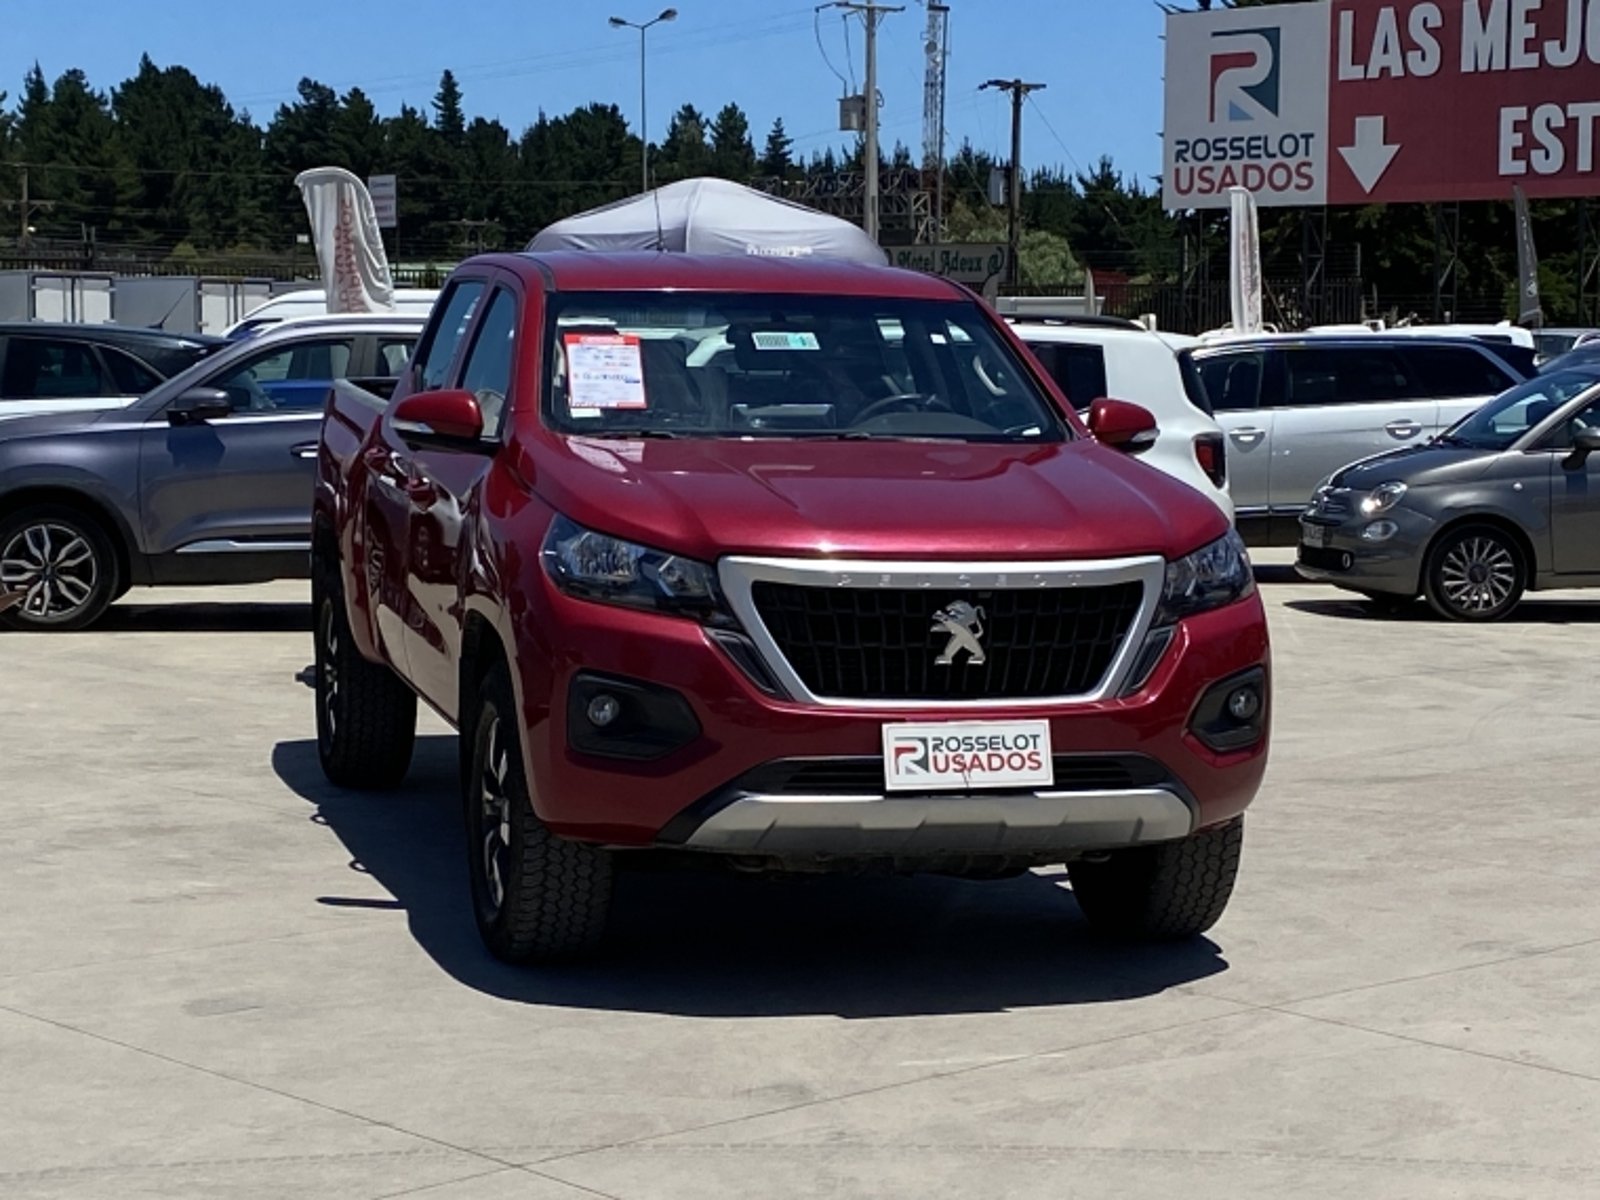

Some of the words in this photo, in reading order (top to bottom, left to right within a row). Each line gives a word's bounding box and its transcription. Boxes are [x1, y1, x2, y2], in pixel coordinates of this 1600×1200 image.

[1338, 3, 1443, 81] LAS
[1174, 133, 1315, 163] ROSSELOT
[1174, 160, 1315, 196] USADOS
[931, 734, 1041, 752] ROSSELOT
[932, 751, 1043, 774] USADOS
